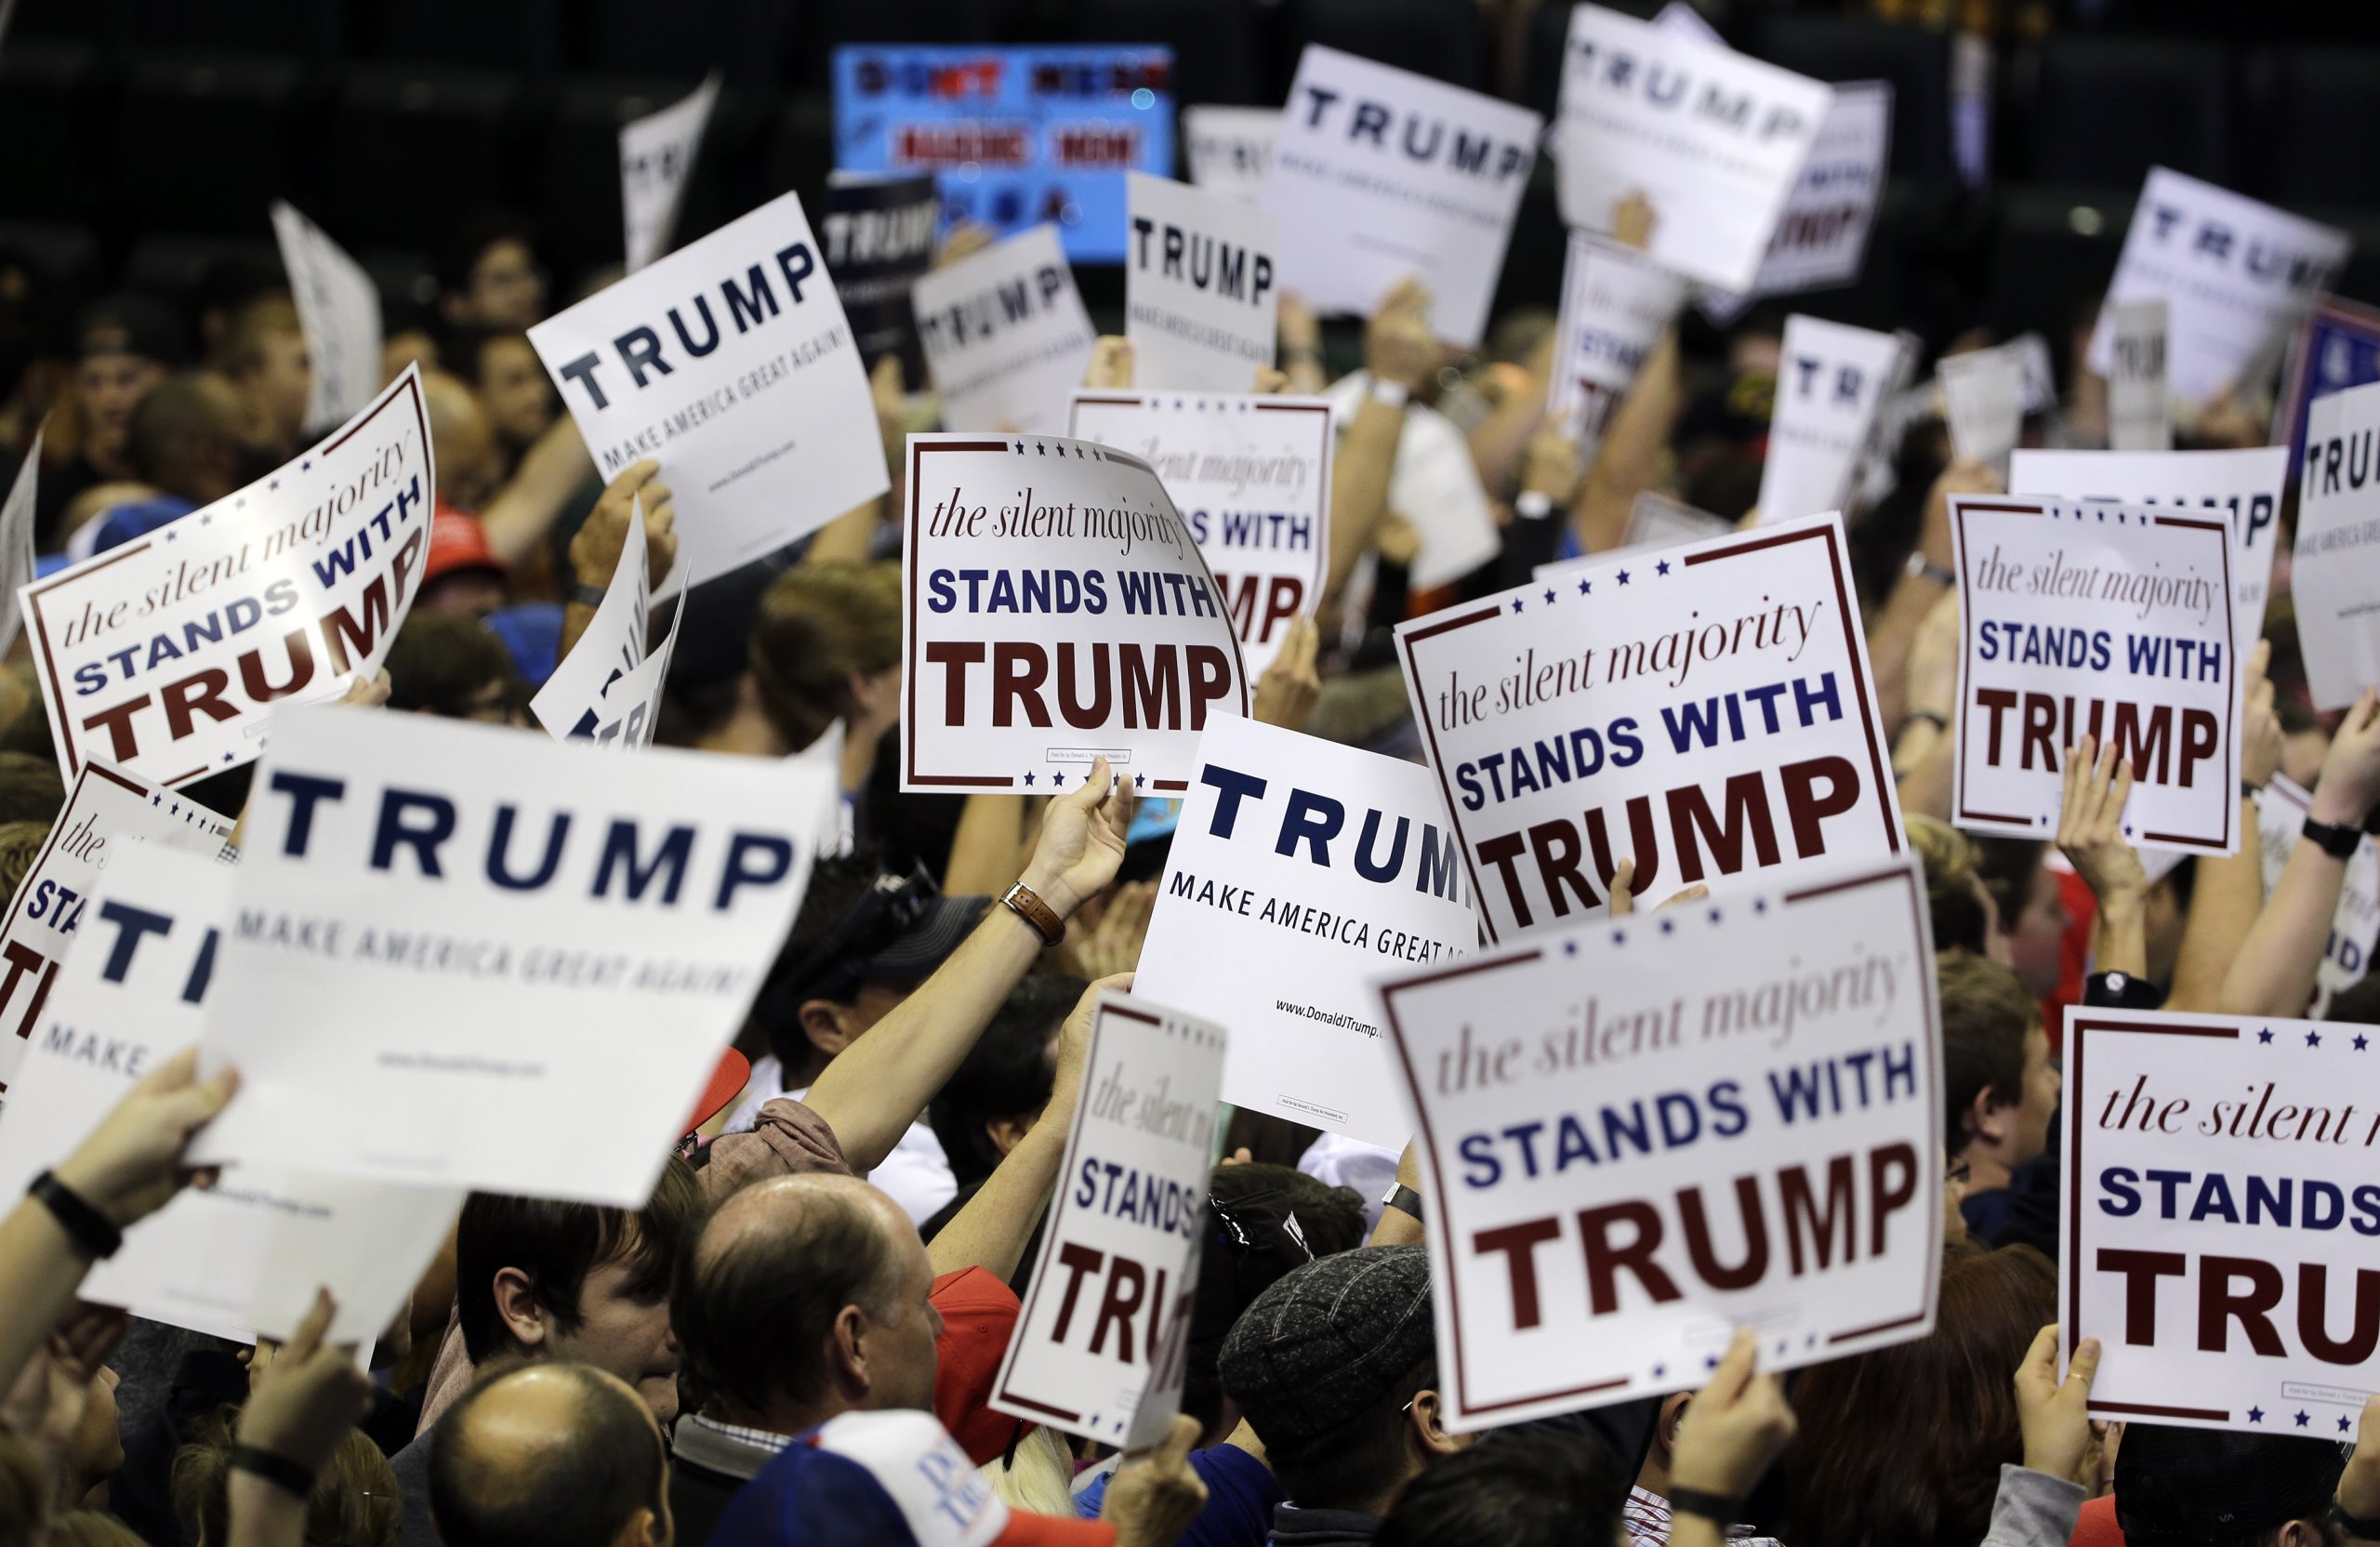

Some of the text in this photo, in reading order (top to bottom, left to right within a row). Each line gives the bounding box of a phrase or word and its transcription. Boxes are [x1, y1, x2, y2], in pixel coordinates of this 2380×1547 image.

[1304, 86, 1525, 181] TRUMP
[1130, 218, 1273, 306] TRUMP
[2154, 204, 2326, 290] TRUM
[560, 243, 814, 410] TRUMP
[603, 427, 661, 471] MAKE
[664, 384, 736, 443] AMERICA
[738, 355, 790, 400] GREAT
[2306, 426, 2380, 500] TRU
[64, 430, 412, 648] the silent majority
[929, 487, 986, 538] the
[992, 487, 1076, 538] silent
[1084, 497, 1184, 561] majority
[1223, 511, 1309, 550] WITH
[73, 474, 422, 696] STANDS WITH
[928, 569, 1108, 614] STANDS
[1117, 571, 1218, 618] WITH
[1977, 544, 2022, 593] the
[2027, 549, 2097, 600] silent
[2101, 562, 2219, 626] majority
[82, 525, 423, 764] TRUMP
[926, 641, 1232, 732] TRUMP
[1440, 595, 1822, 732] the silent majority
[1979, 621, 2222, 683] STANDS WITH
[1456, 671, 1844, 812] STANDS WITH
[1976, 688, 2218, 788] TRUMP
[61, 813, 105, 864] the
[270, 772, 795, 913] TRUMP
[1199, 763, 1473, 910] TRUM
[1475, 756, 1861, 929] TRUMP
[233, 907, 344, 960] MAKE
[352, 926, 511, 980] AMERICA
[520, 943, 627, 991] GREAT
[1169, 870, 1442, 965] MAKE AMERICA GREAT
[42, 1021, 151, 1075] MAKE
[1436, 946, 1908, 1099] the silent majority
[1091, 1062, 1136, 1130] the
[1137, 1076, 1190, 1146] silent
[1459, 1041, 1918, 1191] STANDS WITH
[2098, 1074, 2190, 1134] the
[2197, 1082, 2360, 1146] silent
[1076, 1157, 1197, 1241] STANDS
[1472, 1140, 1919, 1330] TRUMP
[2097, 1167, 2380, 1237] STANDS
[2096, 1248, 2380, 1367] TRU
